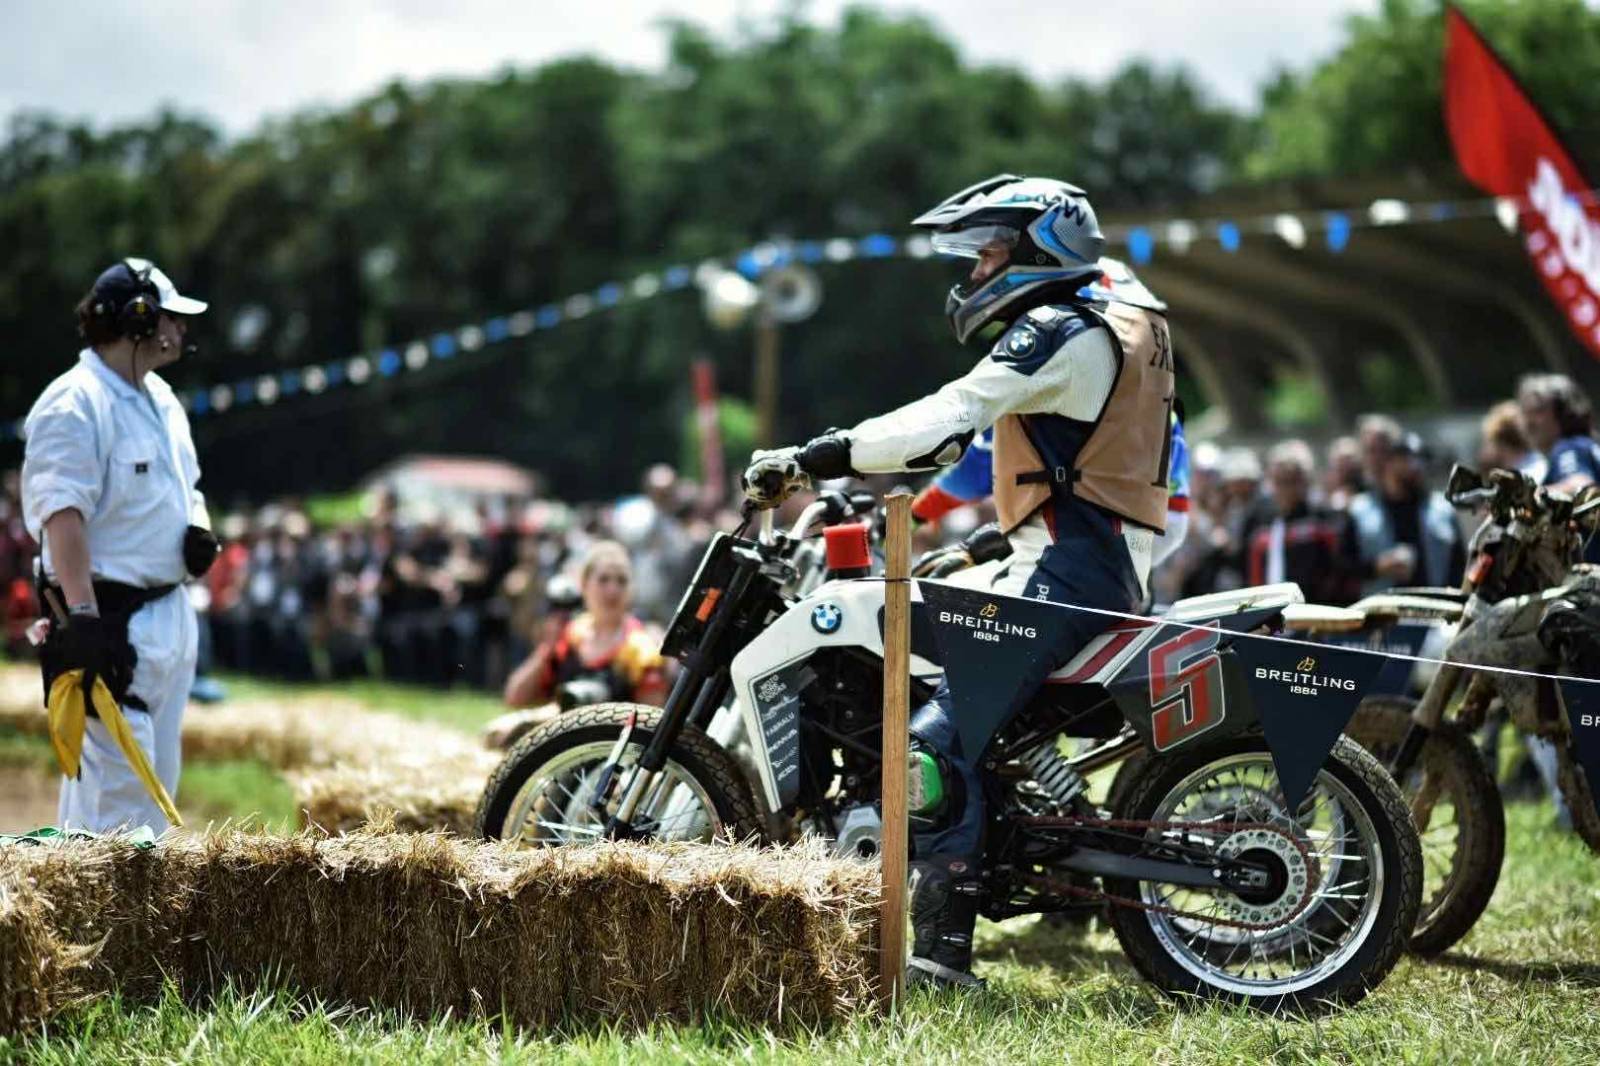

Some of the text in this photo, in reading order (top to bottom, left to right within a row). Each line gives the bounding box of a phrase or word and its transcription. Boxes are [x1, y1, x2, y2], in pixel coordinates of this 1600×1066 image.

[940, 611, 1037, 638] BREITLING
[973, 631, 1000, 642] 1884
[1255, 667, 1356, 691] BREITLING
[1290, 685, 1318, 695] 1884
